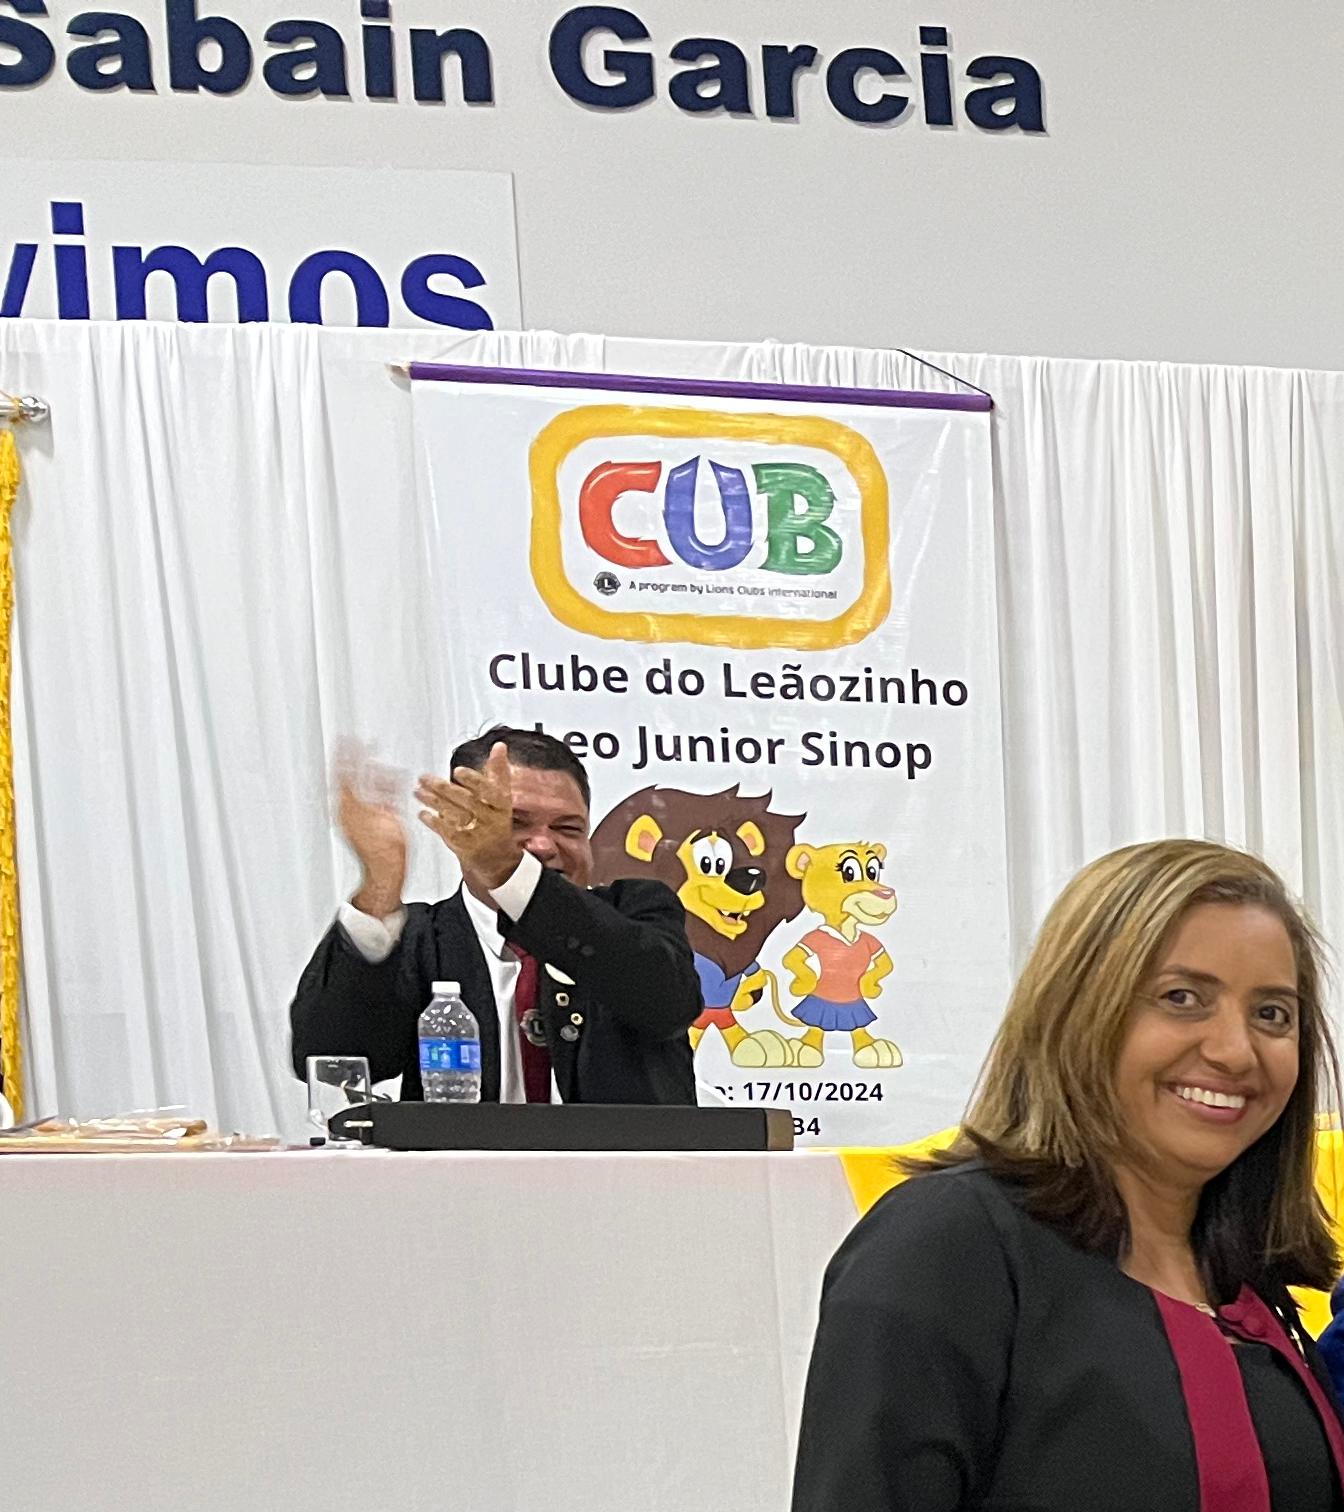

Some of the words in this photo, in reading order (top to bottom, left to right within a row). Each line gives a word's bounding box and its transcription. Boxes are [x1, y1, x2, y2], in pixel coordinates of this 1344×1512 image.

[549, 5, 1046, 132] Garcia
[578, 455, 843, 575] CUB
[639, 581, 687, 594] program
[690, 582, 704, 595] by
[706, 583, 734, 595] Lions
[488, 652, 629, 693] Clube
[645, 658, 706, 696] do
[723, 663, 969, 707] Leãozinho
[535, 723, 620, 760] eo
[632, 725, 786, 770] Junior
[801, 731, 932, 779] Sinop
[743, 1081, 884, 1102] 17/10/2024
